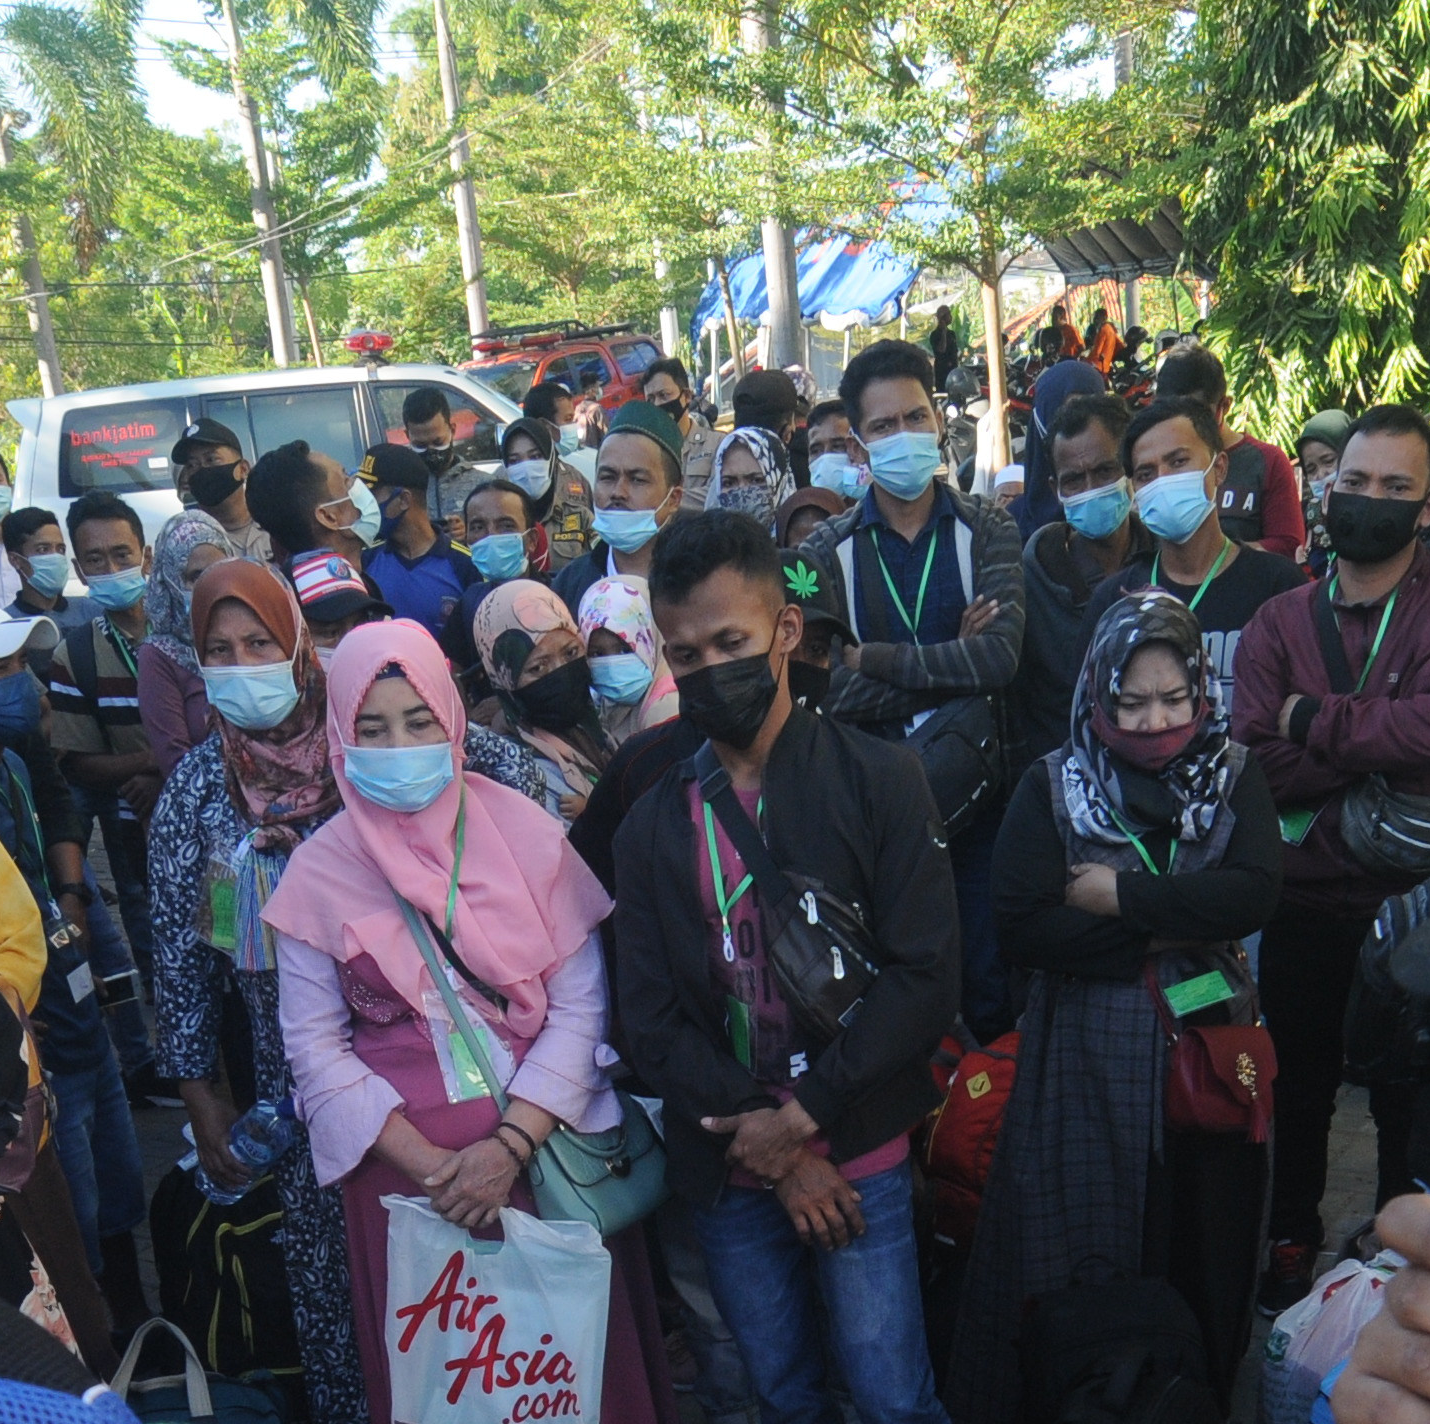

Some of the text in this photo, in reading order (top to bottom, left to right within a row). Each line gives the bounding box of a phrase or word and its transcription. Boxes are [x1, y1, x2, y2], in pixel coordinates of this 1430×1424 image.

[396, 1250, 499, 1353] Air
[444, 1313, 576, 1405] Asia
[502, 1389, 581, 1424] .com
